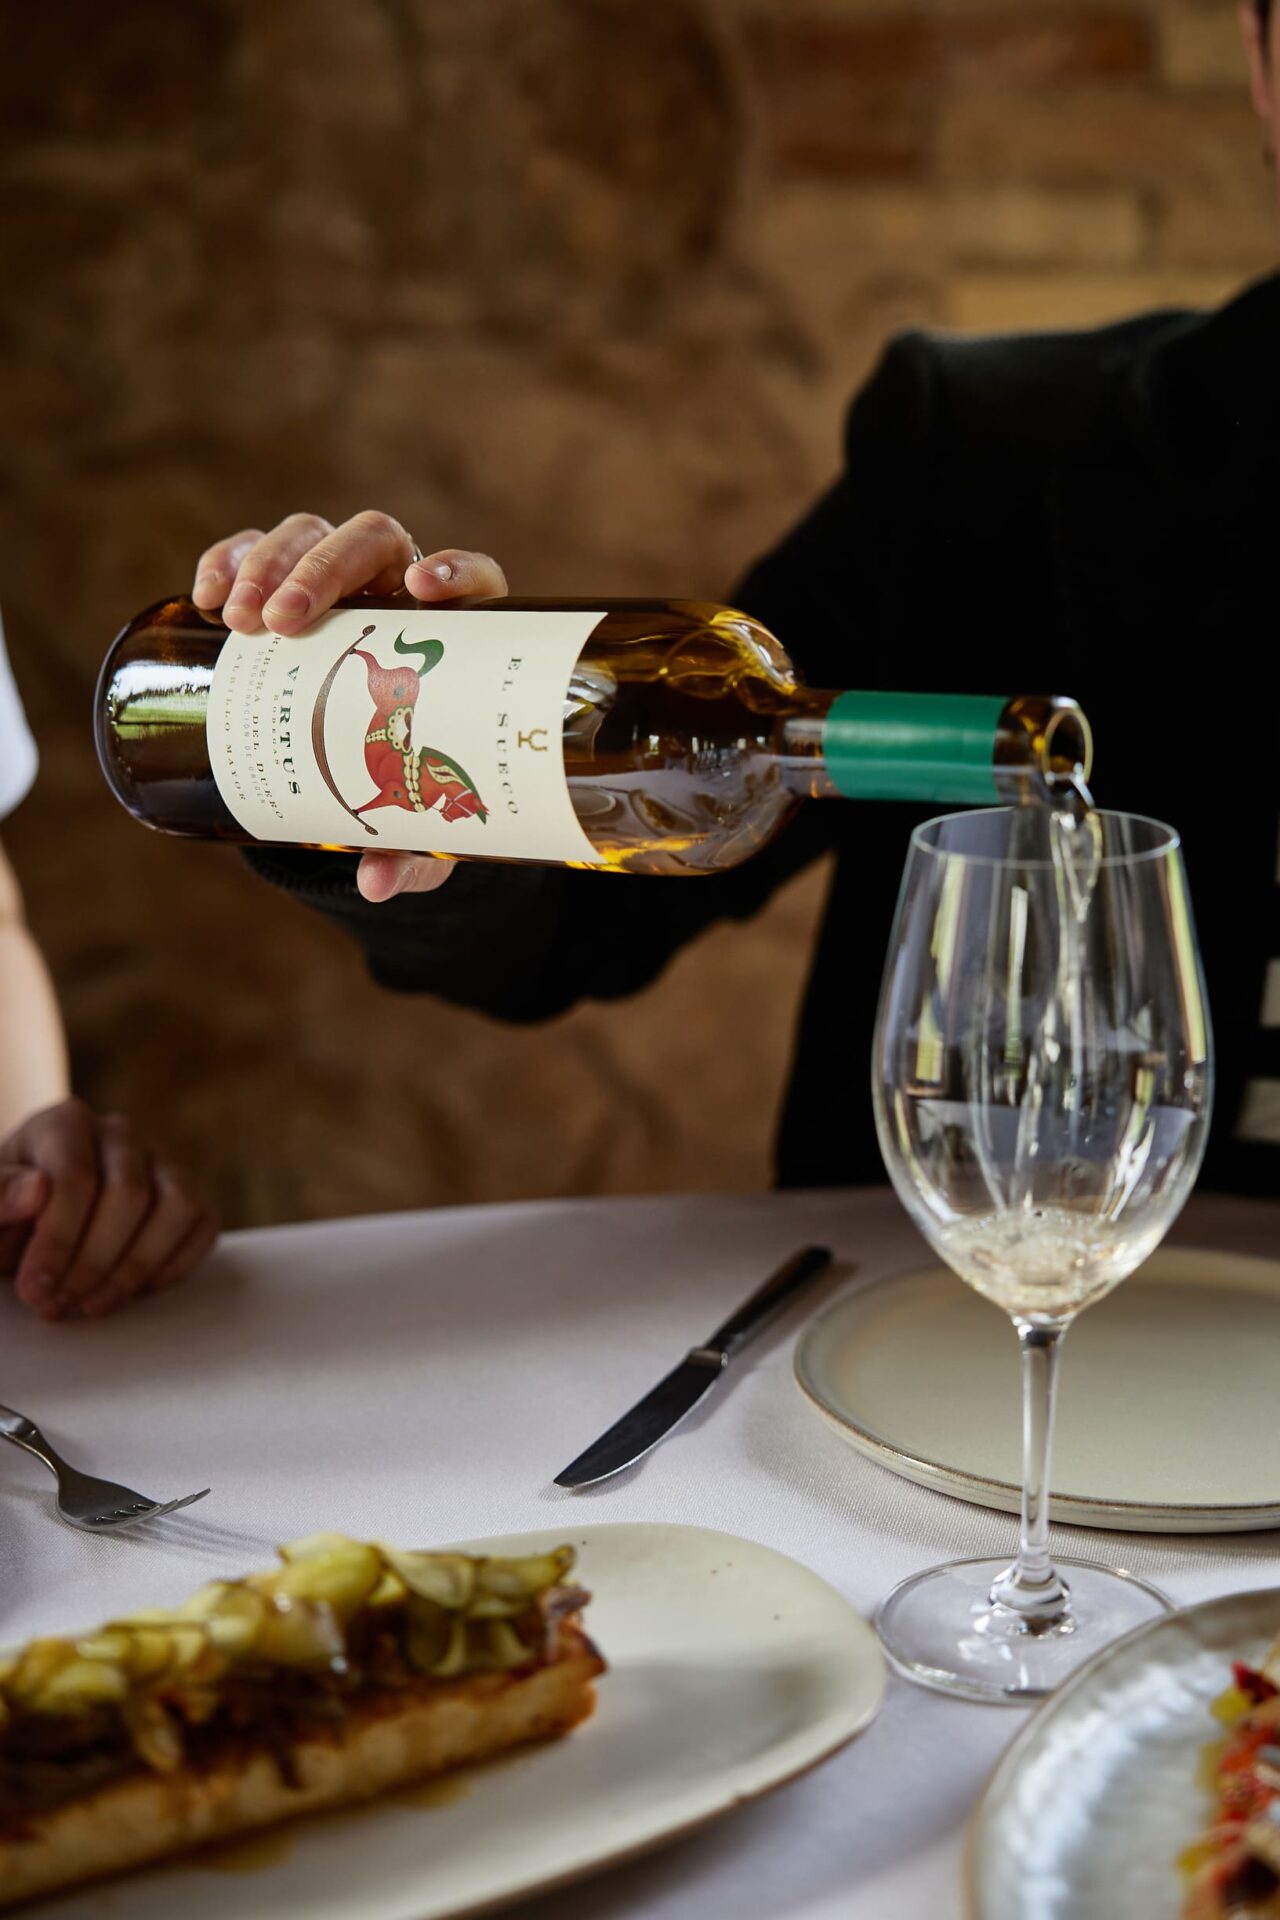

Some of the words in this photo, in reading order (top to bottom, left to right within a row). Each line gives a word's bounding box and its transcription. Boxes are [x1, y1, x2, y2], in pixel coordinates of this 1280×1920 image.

[501, 656, 523, 693] EL
[225, 744, 246, 802] MAYOR
[252, 715, 260, 751] DEL
[256, 762, 284, 820] DUERO
[272, 694, 280, 766] BODEGAS
[279, 664, 302, 796] VIRTUS
[496, 712, 519, 815] SUECO
